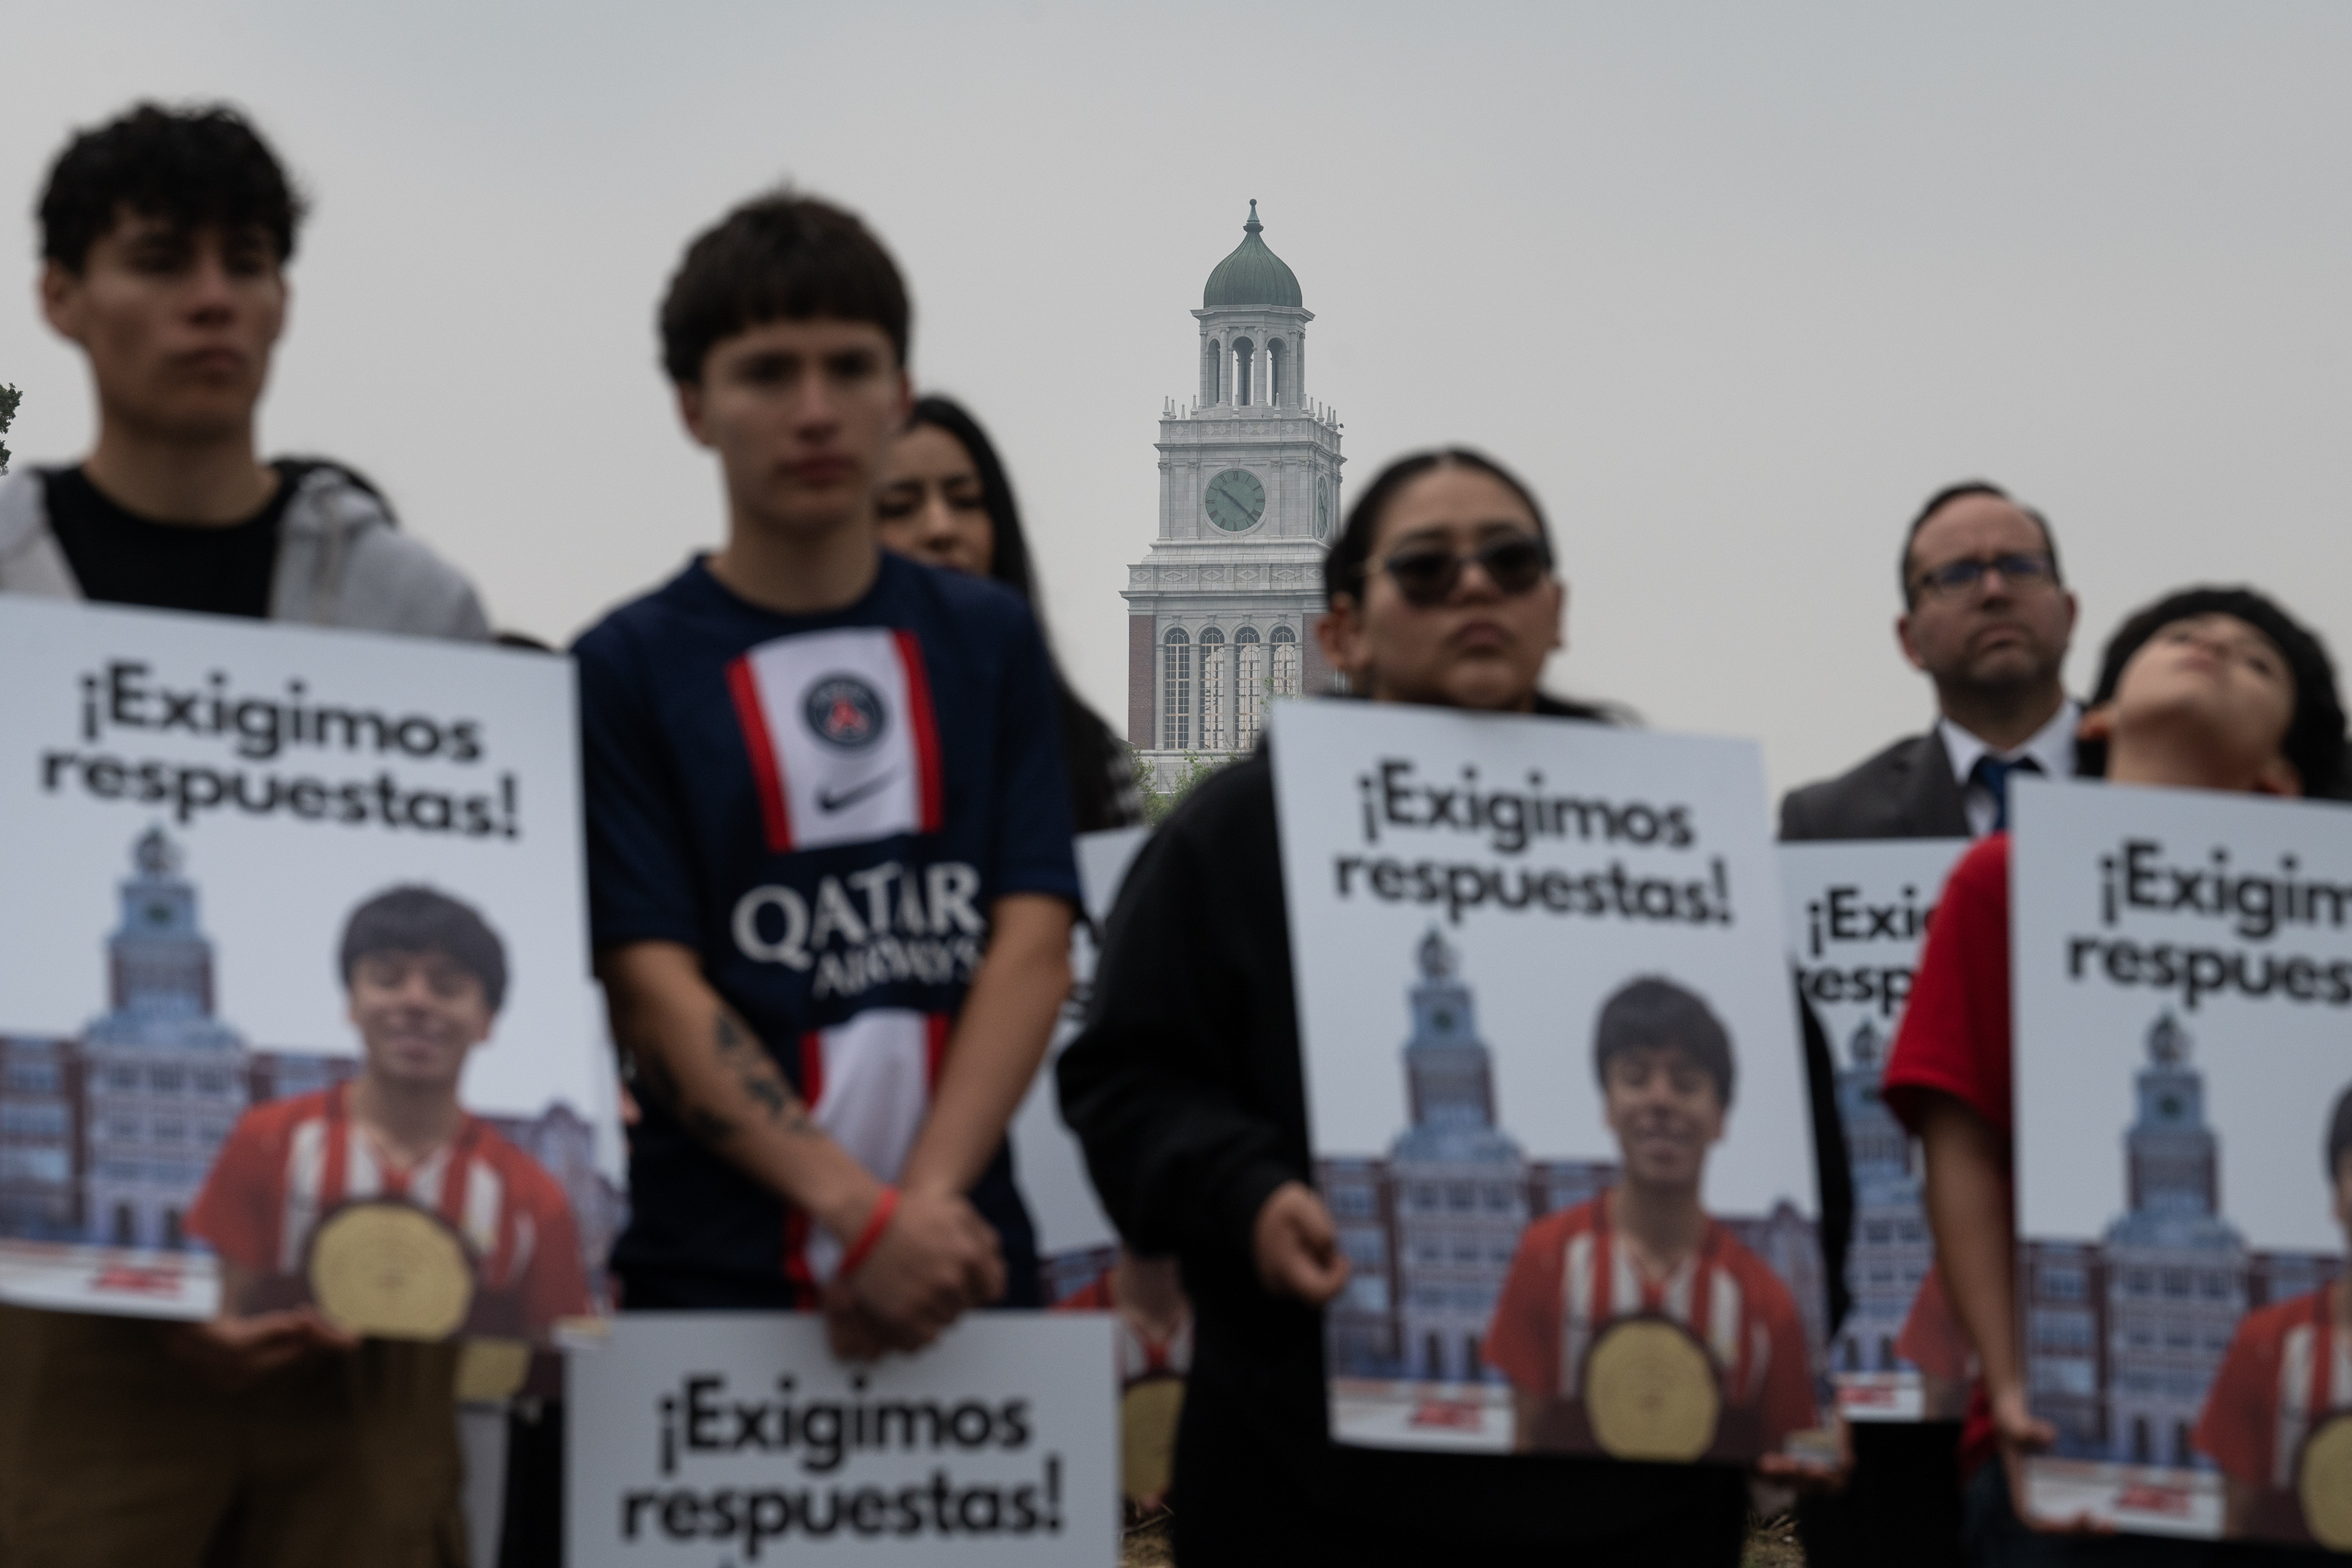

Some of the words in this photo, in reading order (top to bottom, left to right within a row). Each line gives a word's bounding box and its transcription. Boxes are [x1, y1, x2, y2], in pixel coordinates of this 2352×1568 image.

[80, 660, 484, 764] ¡Exigimos
[41, 750, 519, 840] respuestas!
[1358, 758, 1696, 856] ¡Exigimos
[1334, 857, 1733, 927] respuestas!
[1807, 884, 1936, 956] ¡Exi
[659, 1373, 1032, 1475] ¡Exigimos
[620, 1455, 1063, 1562] respuestas!
